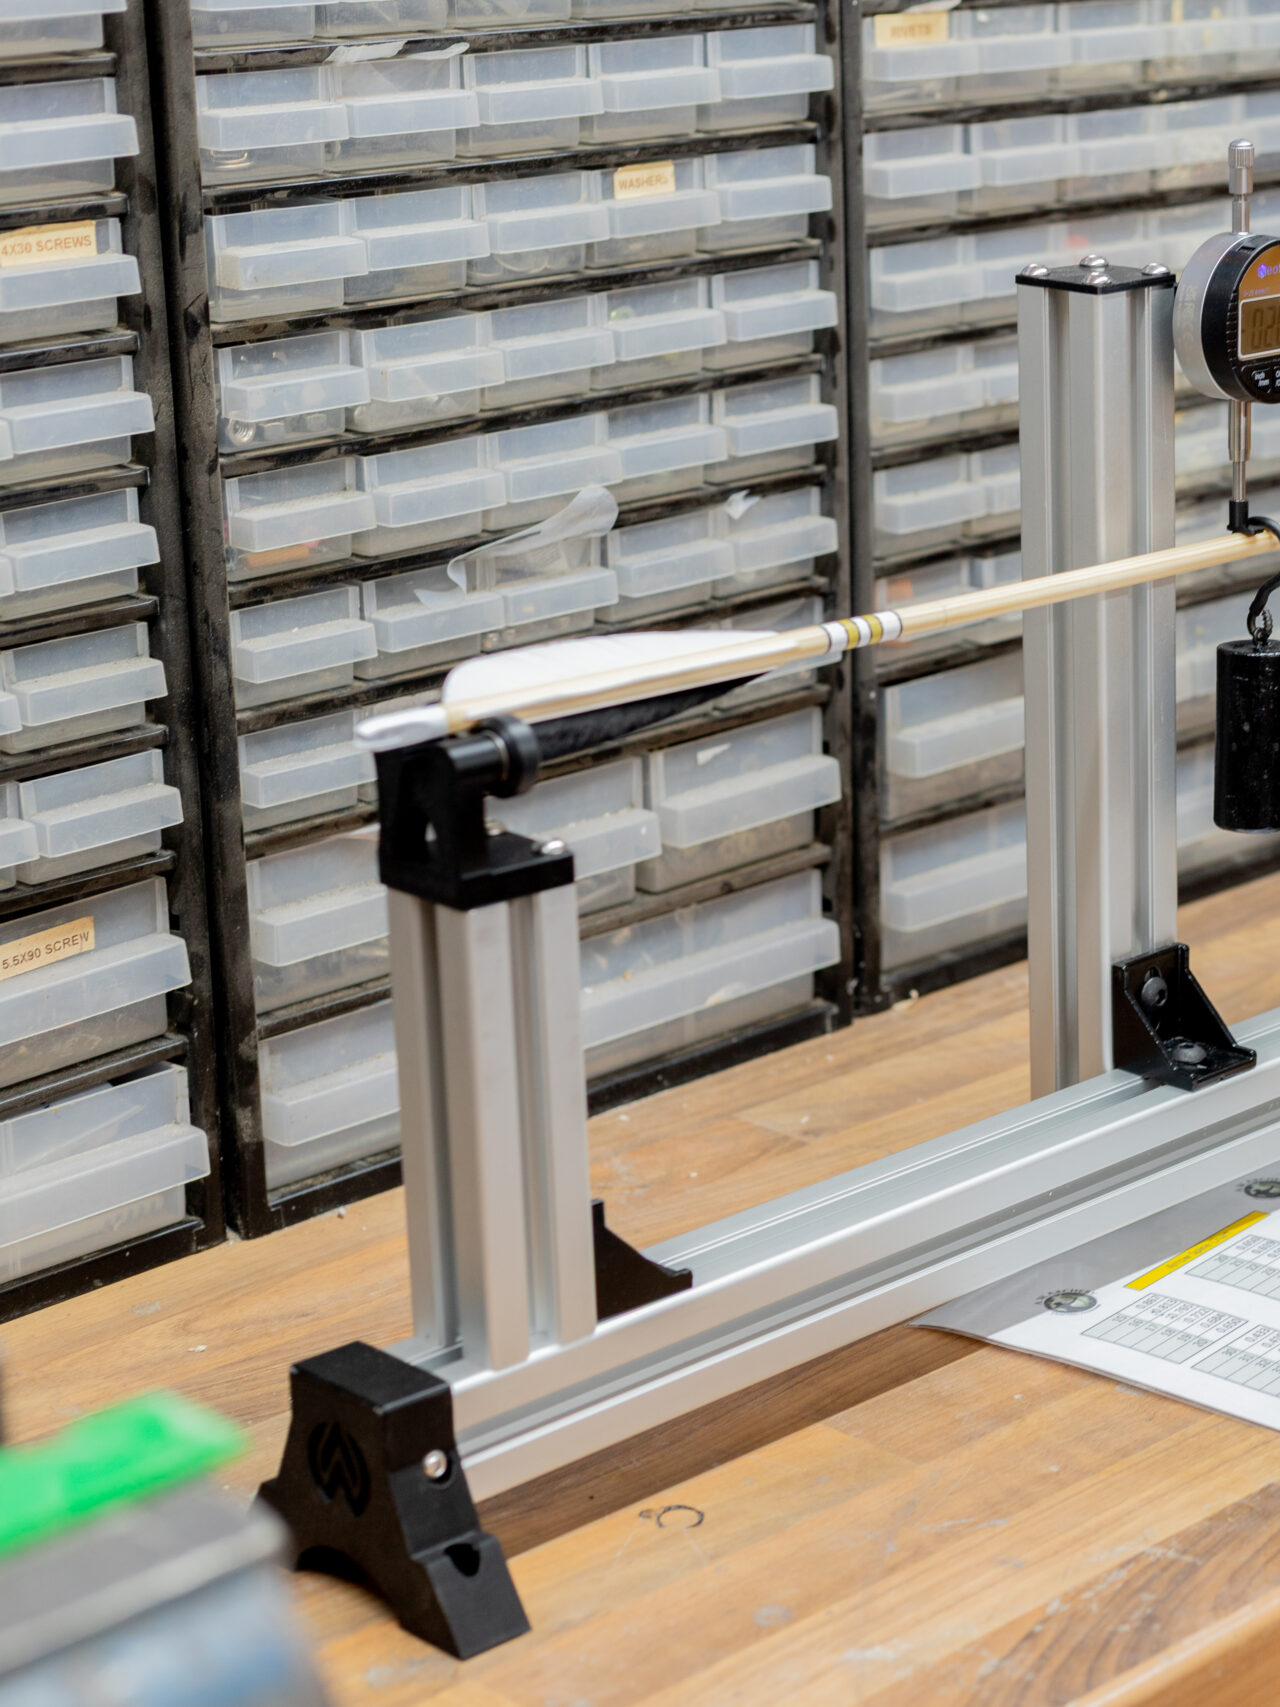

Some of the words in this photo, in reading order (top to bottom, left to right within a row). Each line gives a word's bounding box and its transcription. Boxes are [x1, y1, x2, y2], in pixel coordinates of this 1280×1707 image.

[1, 241, 32, 256] 4X30
[35, 234, 92, 252] SCREWS
[2, 947, 42, 970] 5.5X90
[44, 930, 90, 955] SCREW
